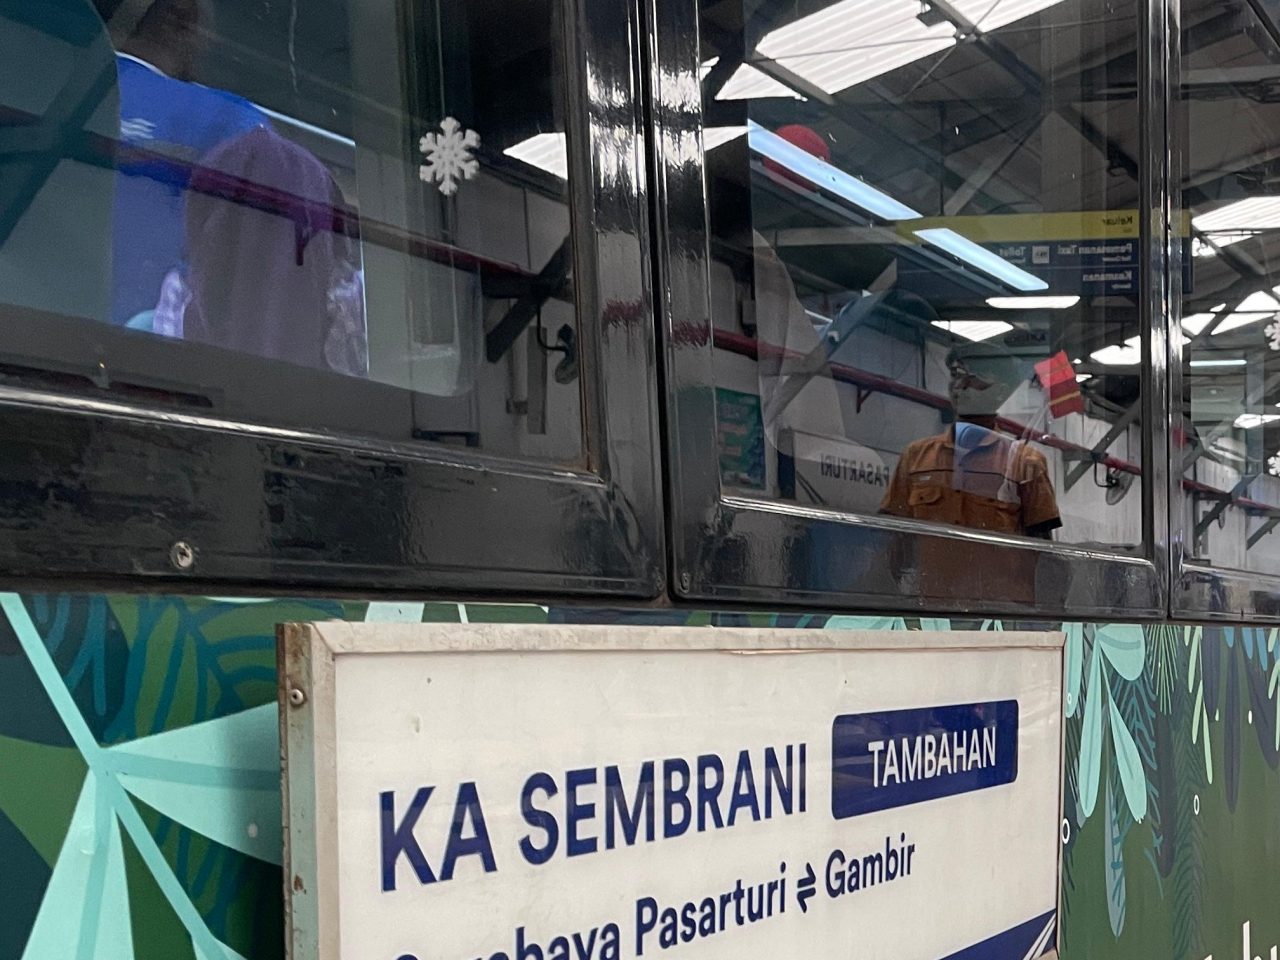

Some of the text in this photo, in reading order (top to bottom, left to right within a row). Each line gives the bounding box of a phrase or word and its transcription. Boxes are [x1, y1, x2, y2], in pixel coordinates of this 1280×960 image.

[378, 726, 997, 893] KA SEMBRANI TAMBAHAN
[635, 862, 787, 957] Pasarturi
[825, 831, 916, 900] Gambir
